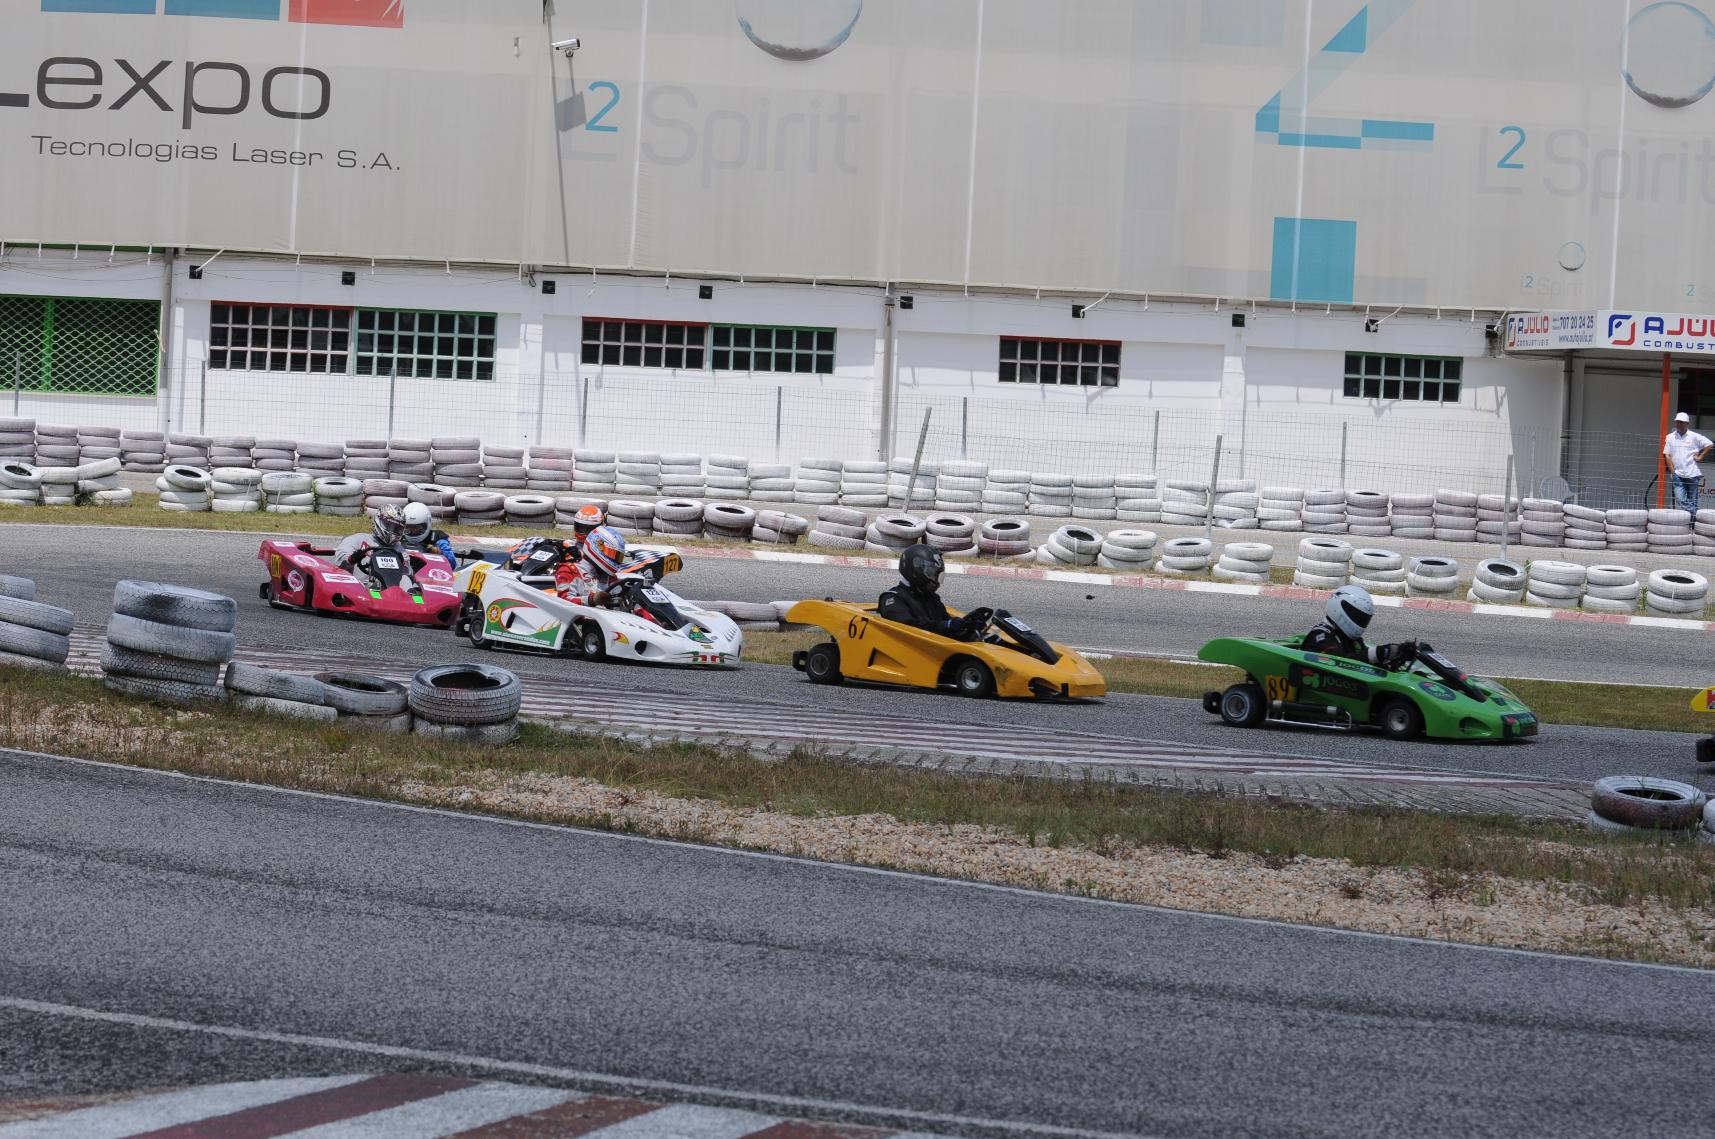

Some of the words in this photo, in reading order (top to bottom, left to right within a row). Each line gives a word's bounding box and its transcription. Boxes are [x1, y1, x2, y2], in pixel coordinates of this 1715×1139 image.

[0, 54, 332, 130] expo
[641, 84, 863, 189] Spirit
[31, 133, 218, 162] Tecnologias
[232, 142, 324, 167] Laser
[337, 149, 402, 171] S.A.
[1560, 316, 1569, 329] 707
[1570, 316, 1577, 329] 20
[1578, 316, 1585, 329] 24
[1586, 315, 1594, 329] 25
[664, 557, 679, 573] 127
[467, 570, 487, 595] 123
[847, 614, 870, 640] 67
[1267, 677, 1290, 700] 89
